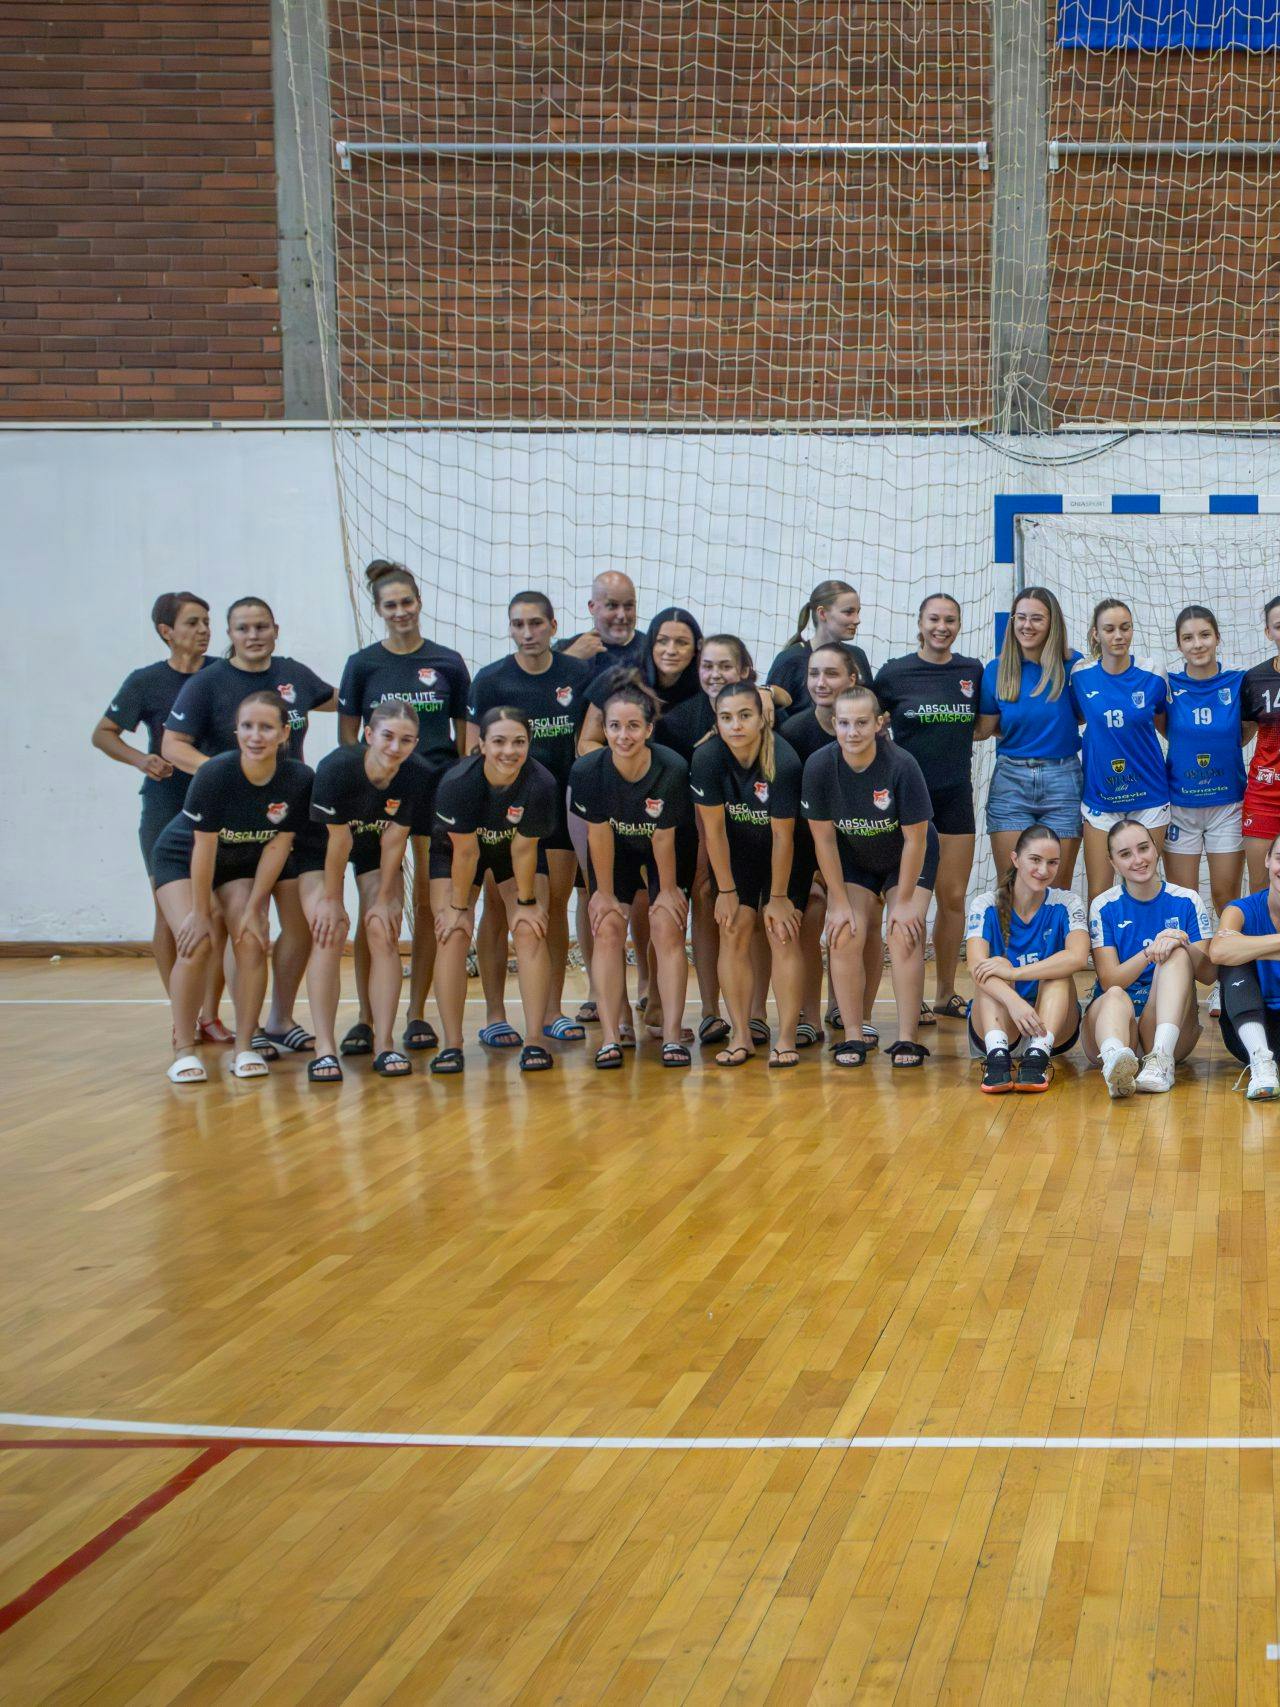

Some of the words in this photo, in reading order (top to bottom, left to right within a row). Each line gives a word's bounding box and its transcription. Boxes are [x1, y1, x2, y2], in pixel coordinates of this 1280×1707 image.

[917, 703, 971, 713] ABSOLUTE
[1103, 709, 1124, 728] 13
[1191, 707, 1213, 725] 19
[838, 817, 891, 829] ABSOLUTE
[1016, 952, 1040, 966] 15
